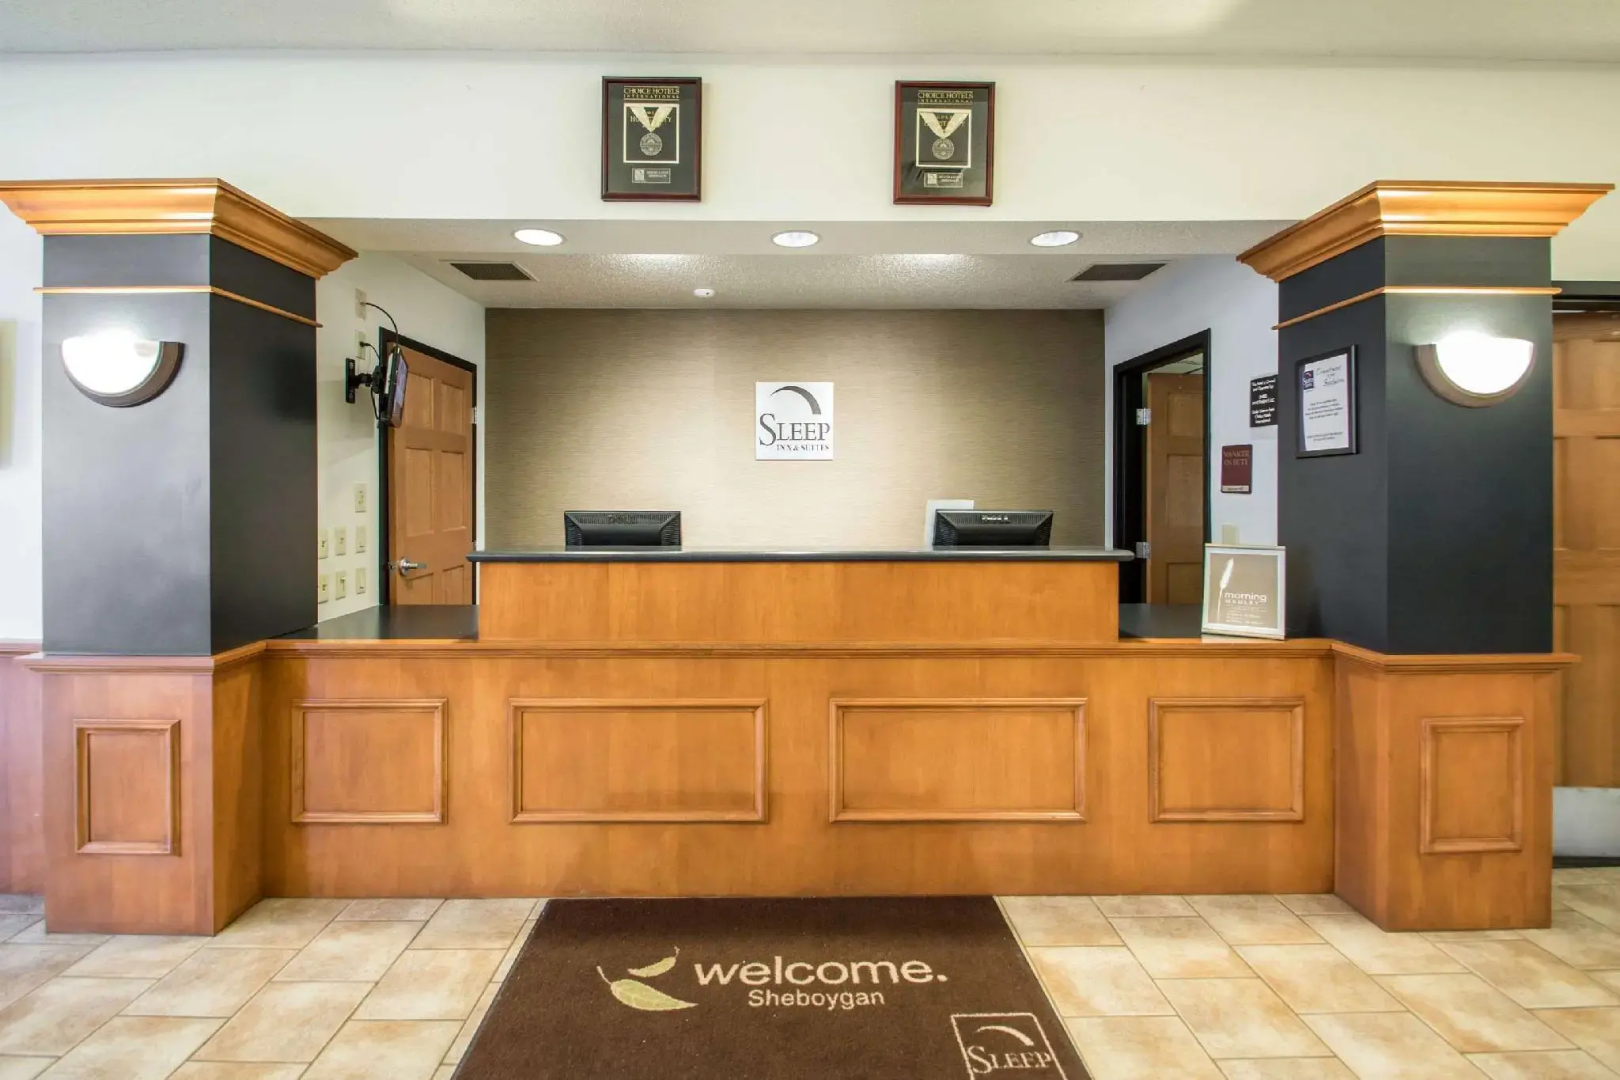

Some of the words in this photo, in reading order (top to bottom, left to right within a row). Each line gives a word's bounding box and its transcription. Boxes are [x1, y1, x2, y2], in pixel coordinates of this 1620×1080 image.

[623, 87, 651, 95] CHOICE
[652, 87, 680, 95] HOTELS
[1224, 592, 1267, 603] morning
[694, 956, 948, 986] welcome.
[748, 988, 885, 1010] Sheboygan
